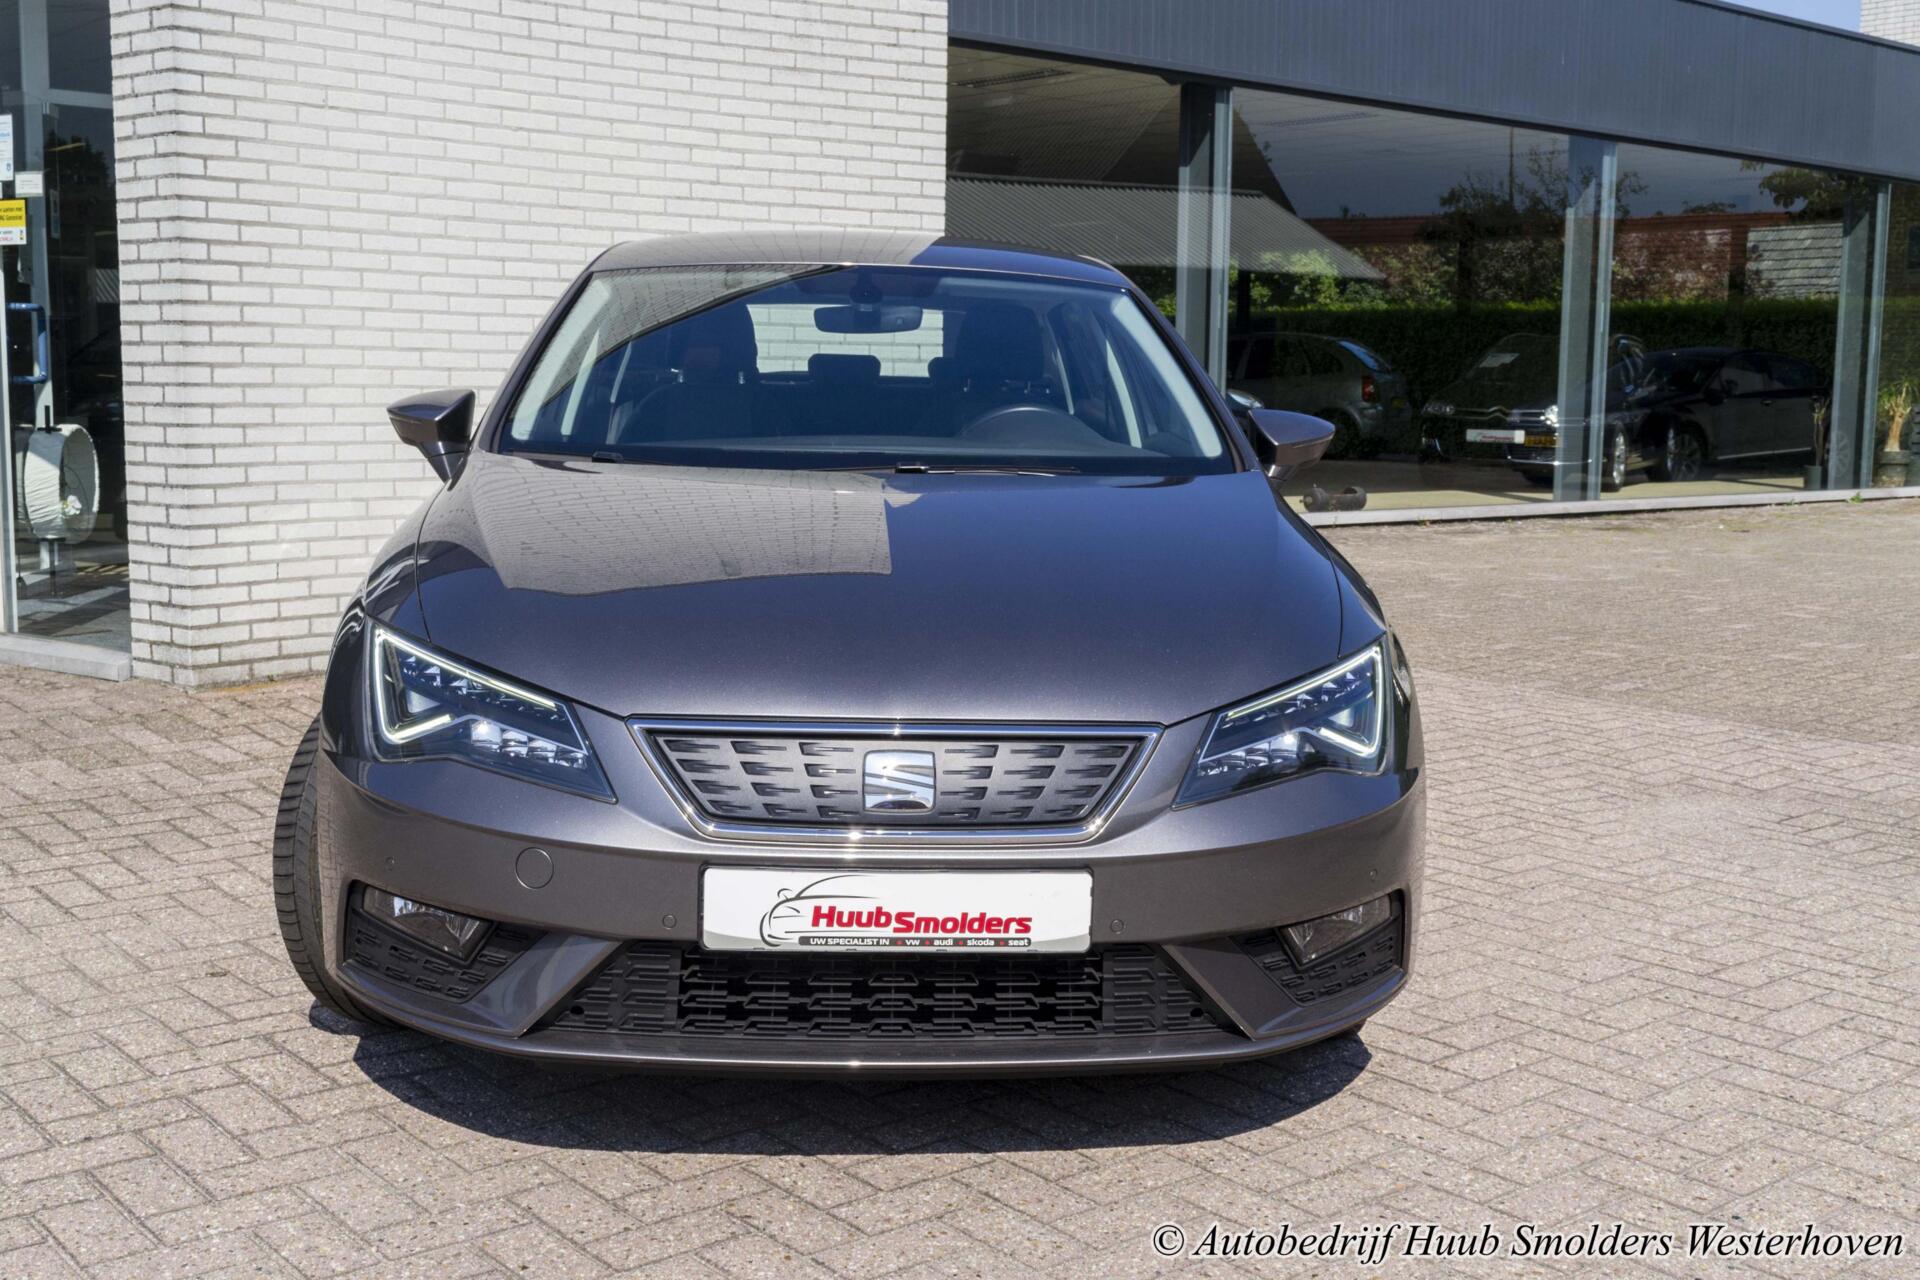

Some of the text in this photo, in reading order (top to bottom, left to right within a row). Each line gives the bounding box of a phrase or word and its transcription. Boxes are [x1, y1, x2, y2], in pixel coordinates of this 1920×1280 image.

[933, 938, 954, 946] audi
[966, 938, 995, 946] skoda
[1008, 938, 1029, 946] seat
